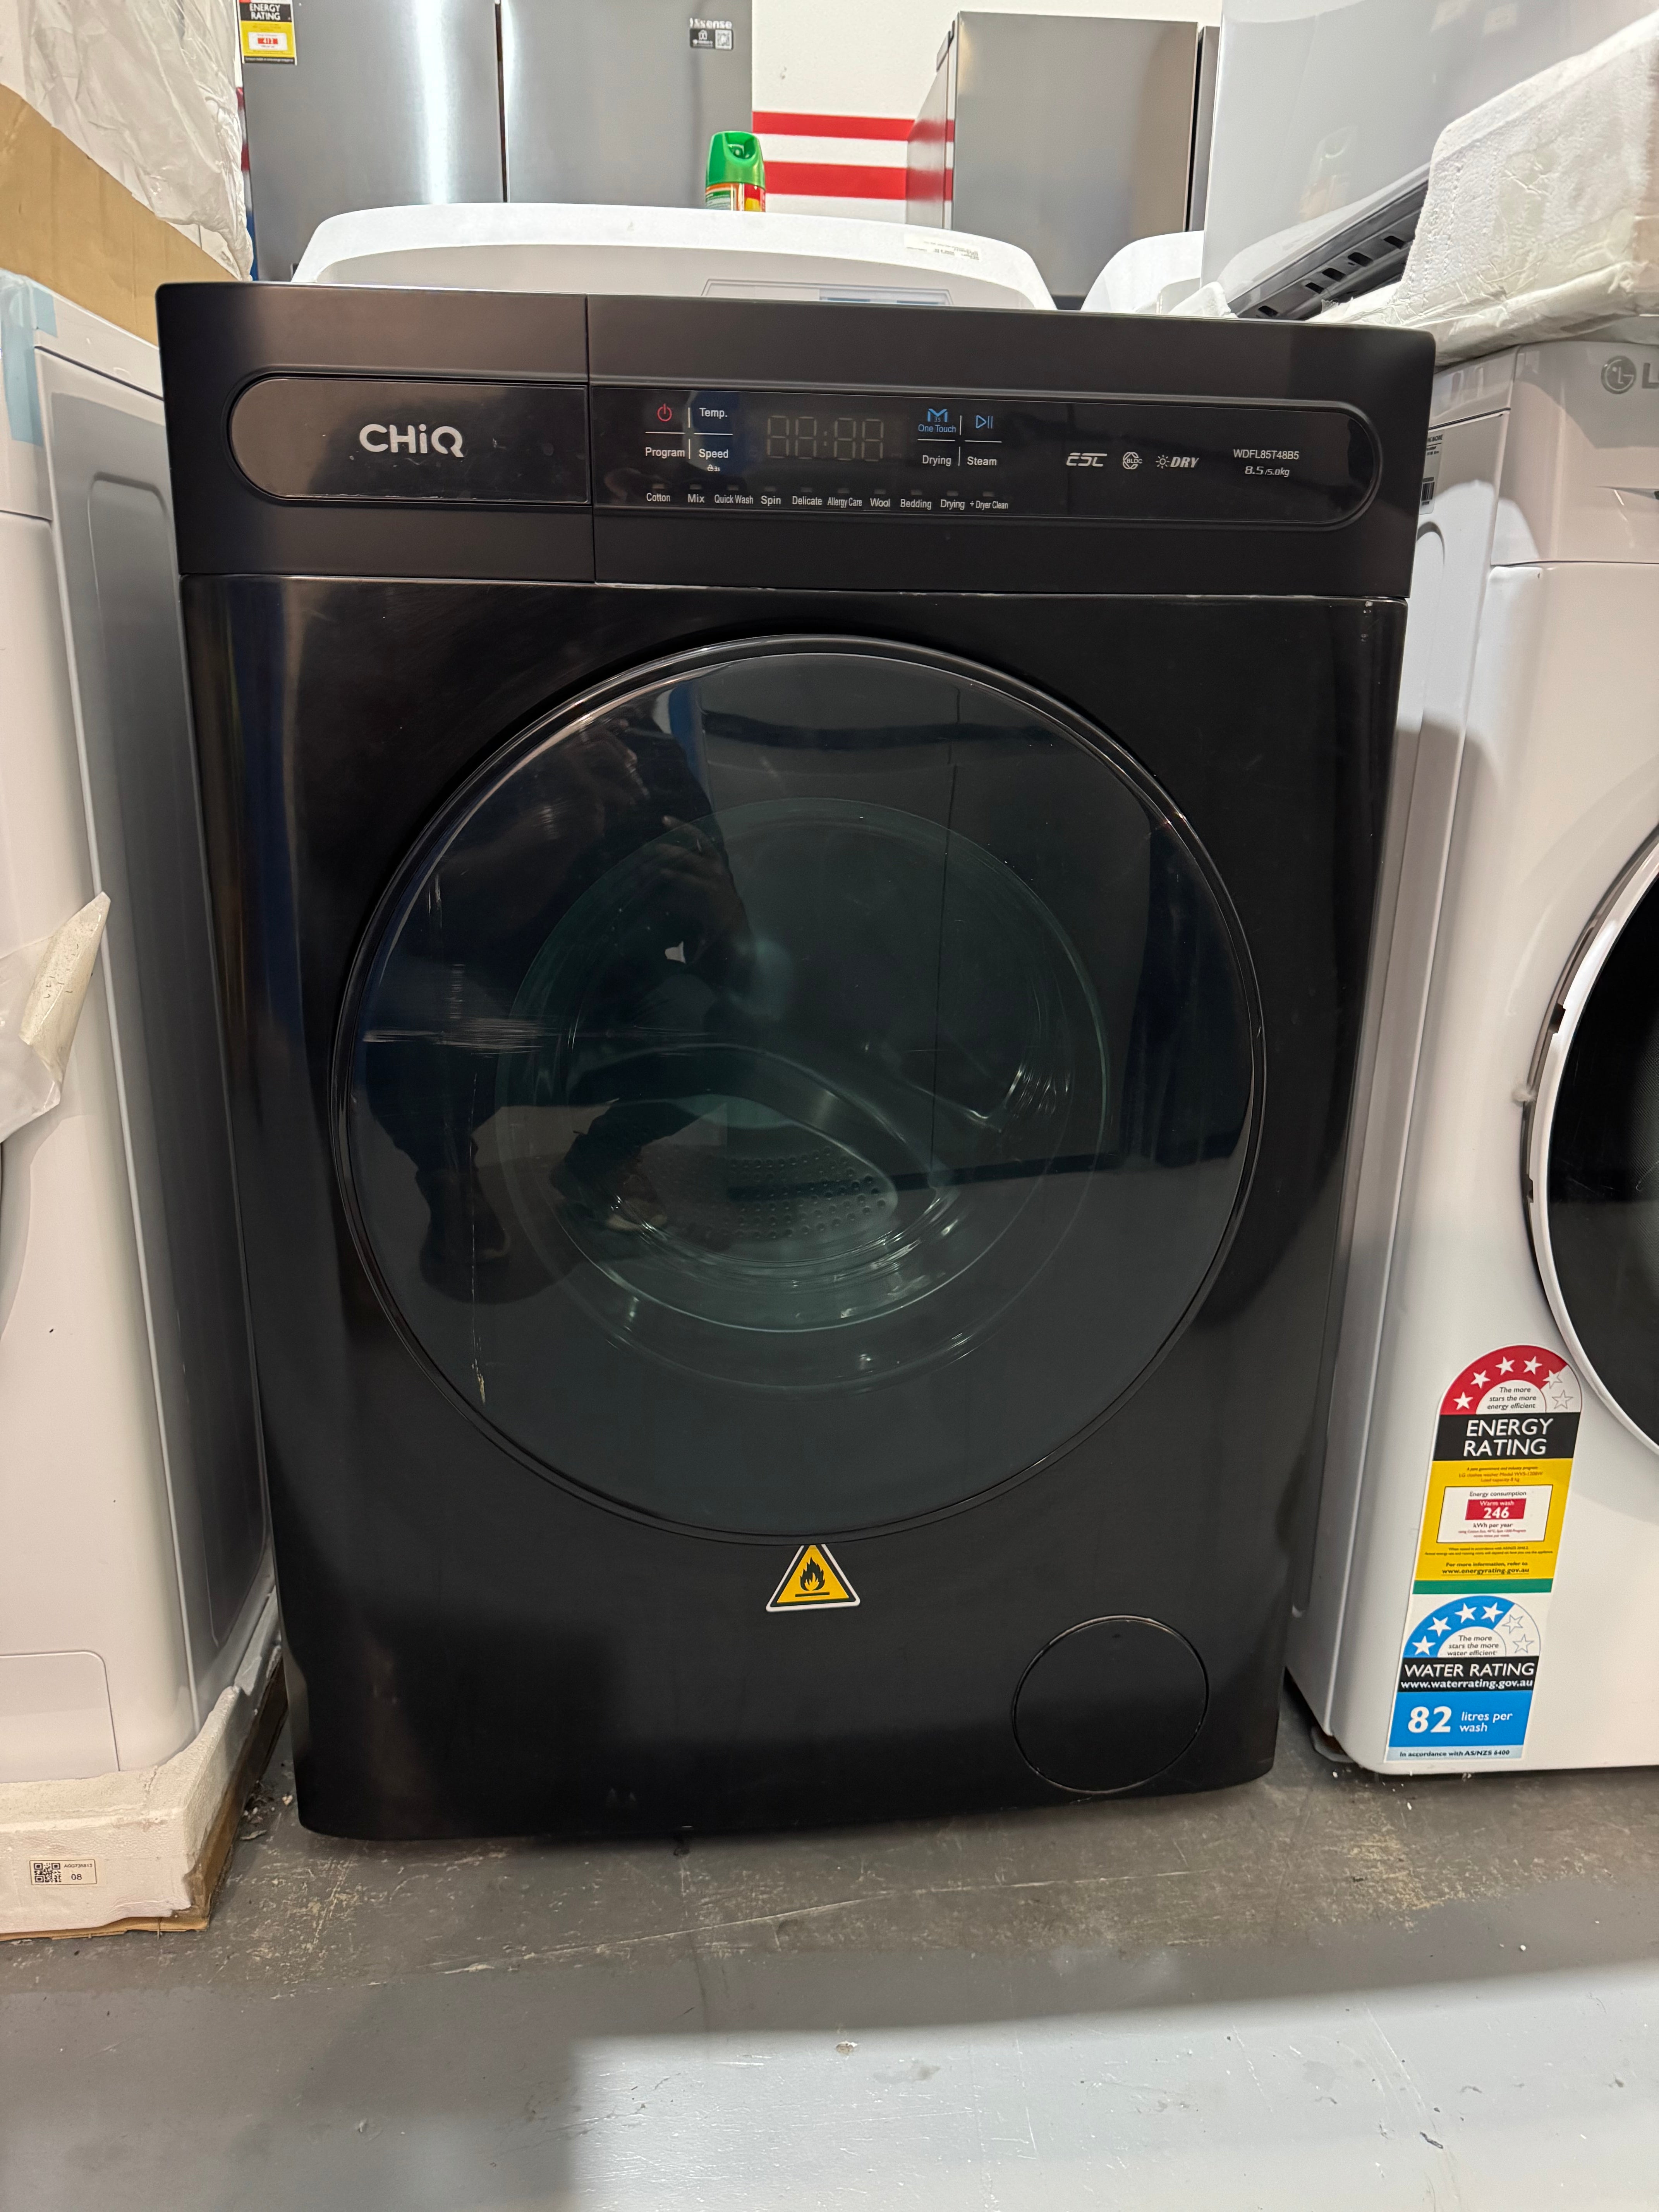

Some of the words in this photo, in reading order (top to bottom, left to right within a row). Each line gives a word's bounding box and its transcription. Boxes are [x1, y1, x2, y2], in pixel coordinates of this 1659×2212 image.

[250, 3, 280, 12] ENERGY
[251, 12, 280, 20] RATING
[1642, 362, 1659, 389] L
[699, 407, 728, 419] Temp.
[918, 424, 933, 432] One
[935, 424, 956, 433] Touch
[359, 424, 464, 457] CHiQ
[645, 447, 685, 459] Program
[699, 448, 728, 460] Speed
[1233, 449, 1299, 460] WDFL85T48B5
[922, 455, 951, 466] Drying
[967, 456, 997, 465] Steam
[1170, 457, 1199, 468] DRY
[646, 493, 670, 502] Cotton
[688, 494, 704, 503] Mix
[714, 494, 733, 504] Quick
[735, 495, 753, 504] Wash
[761, 495, 781, 506] Spin
[792, 496, 822, 505] Delicate
[827, 497, 848, 508] Allergy
[848, 497, 862, 506] Care
[870, 498, 890, 507] Wool
[900, 499, 931, 510] Bedding
[940, 499, 965, 510] Drying
[976, 500, 991, 510] Dryer
[992, 500, 1008, 509] Clean
[1466, 1418, 1553, 1436] ENERGY
[1463, 1438, 1547, 1456] RATING
[1483, 1507, 1509, 1518] 246
[1404, 1664, 1464, 1677] WATER
[1470, 1663, 1535, 1677] RATING
[1401, 1679, 1533, 1689] www.waterrating.gov.au
[1408, 1706, 1452, 1733] 82
[1461, 1712, 1489, 1721] litres
[1492, 1713, 1513, 1723] per
[1459, 1723, 1488, 1732] wash
